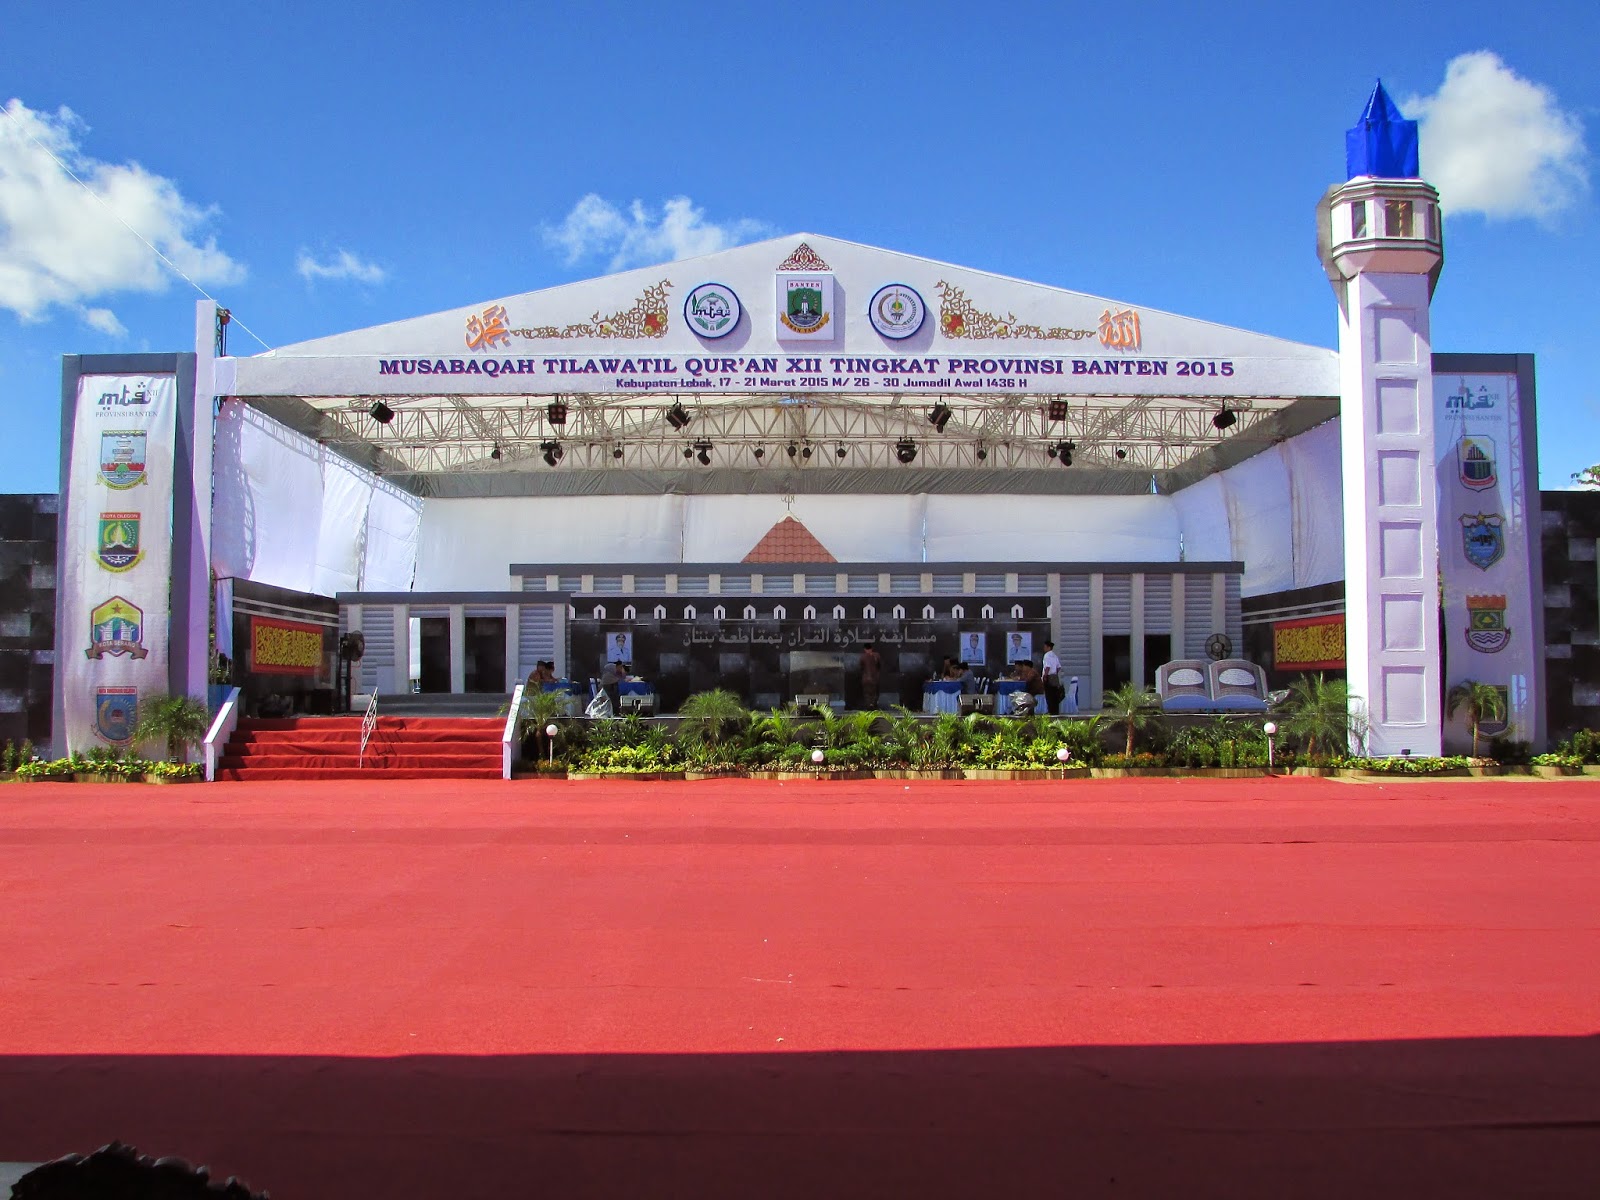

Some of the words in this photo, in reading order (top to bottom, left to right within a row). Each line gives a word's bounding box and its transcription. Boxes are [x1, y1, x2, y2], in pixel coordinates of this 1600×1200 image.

[379, 359, 535, 378] MUSABAQAH
[542, 358, 678, 375] TILAWATIL
[684, 358, 778, 377] QUR'AN
[785, 358, 822, 374] XII
[829, 358, 940, 374] TINGKAT
[947, 358, 1063, 375] PROVINSI
[1071, 360, 1168, 376] BANTEN
[1176, 361, 1235, 377] 2015
[616, 378, 678, 390] Kabupaten
[719, 377, 731, 387] 17
[744, 377, 756, 387] 21
[760, 377, 796, 387] Maret
[799, 377, 828, 387] 2015
[854, 377, 870, 387] 26
[883, 377, 899, 387] 30
[903, 378, 950, 388] Jumadil
[954, 378, 983, 388] Awal
[987, 378, 1015, 388] 1436
[1019, 379, 1027, 388] H
[833, 627, 876, 648] تلاوة
[879, 626, 937, 649] مسابقة
